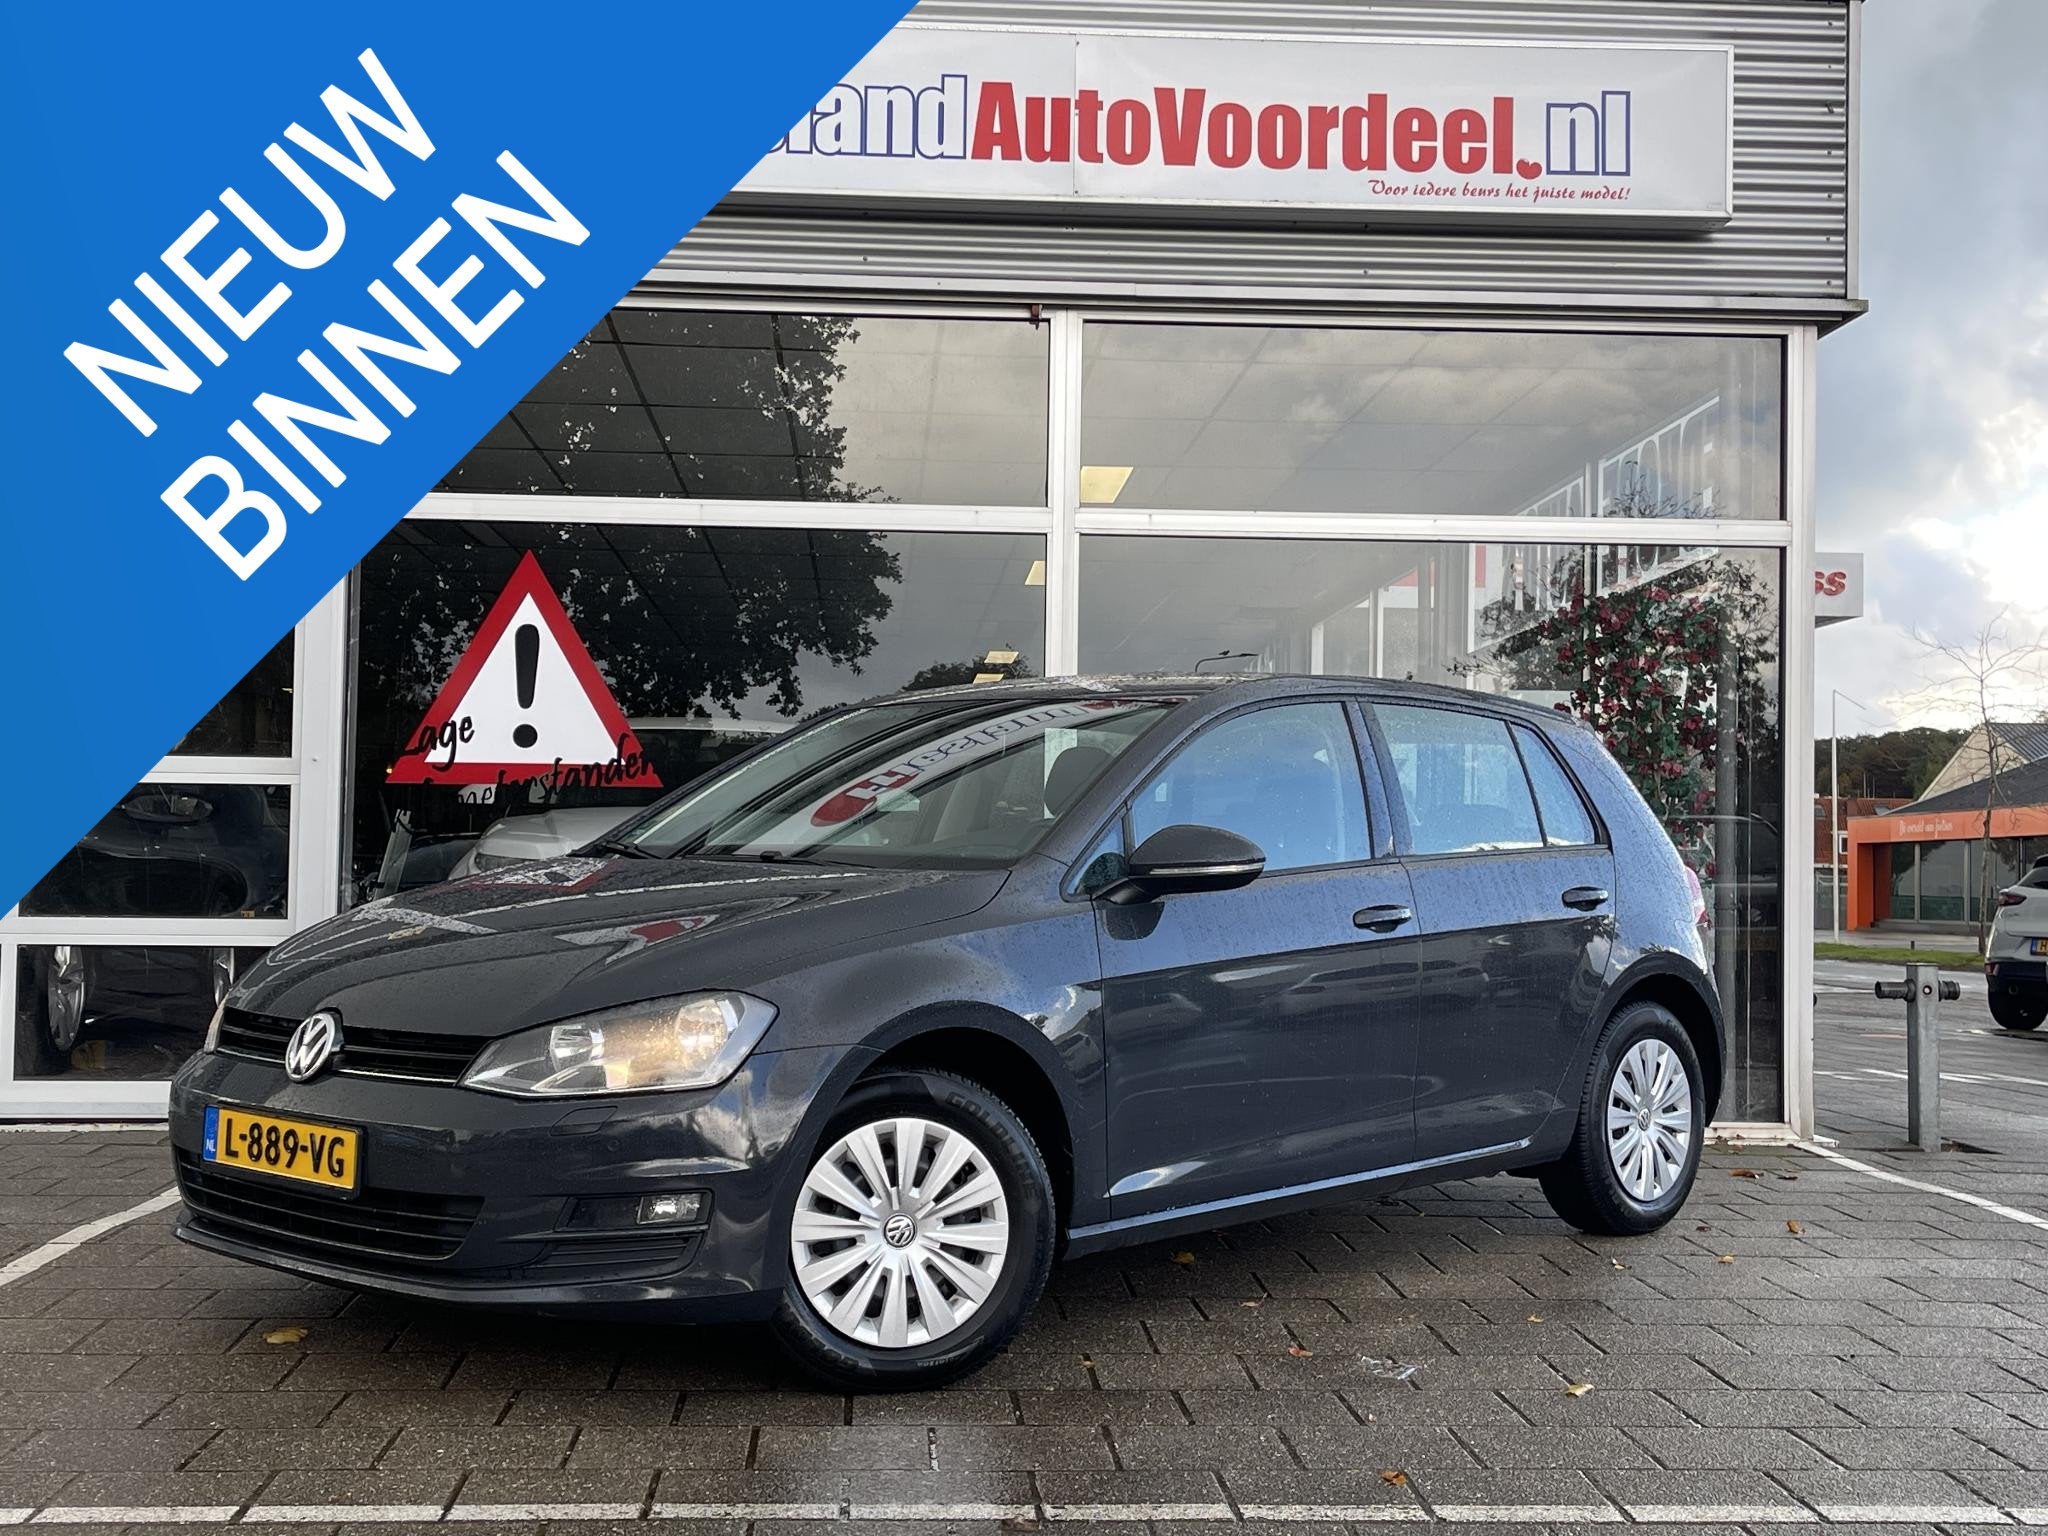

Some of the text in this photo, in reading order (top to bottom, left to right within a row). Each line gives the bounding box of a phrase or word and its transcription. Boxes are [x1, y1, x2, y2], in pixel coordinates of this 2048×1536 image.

[1368, 180, 1631, 203] Voor iedere beurs het juiste model!
[225, 1118, 345, 1178] L-889-VG
